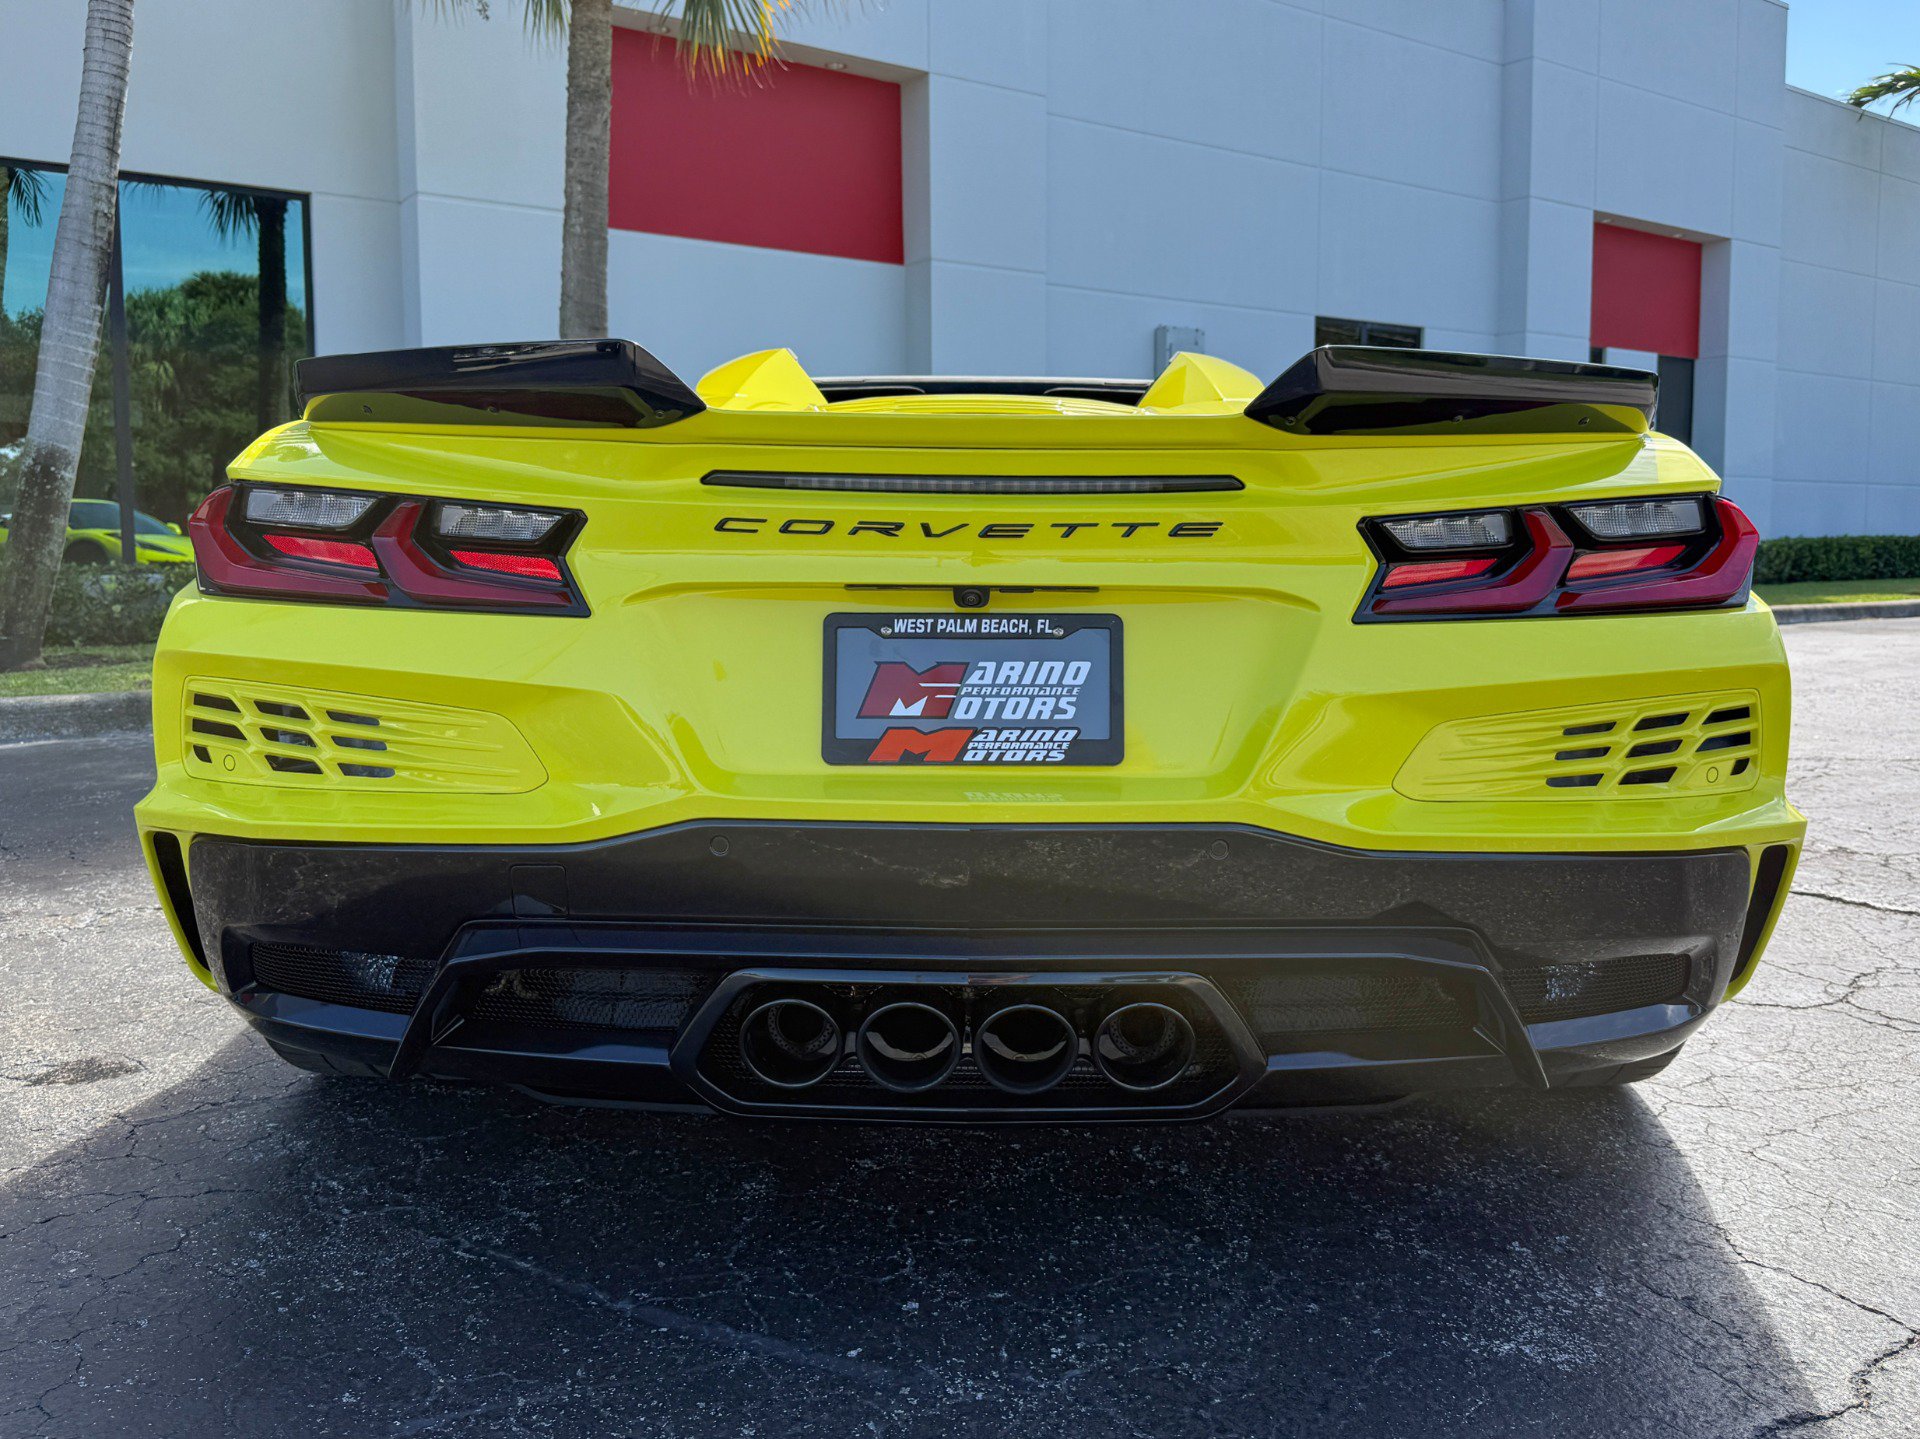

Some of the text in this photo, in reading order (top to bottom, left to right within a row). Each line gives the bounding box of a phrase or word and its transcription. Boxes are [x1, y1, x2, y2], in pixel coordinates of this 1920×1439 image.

[713, 517, 1224, 539] CORVETTE
[894, 618, 935, 634] WEST
[937, 619, 978, 634] PALM
[981, 619, 1032, 636] BEACH,
[960, 687, 1081, 696] PERFORMANCE
[967, 742, 1070, 750] PERFORMANCE
